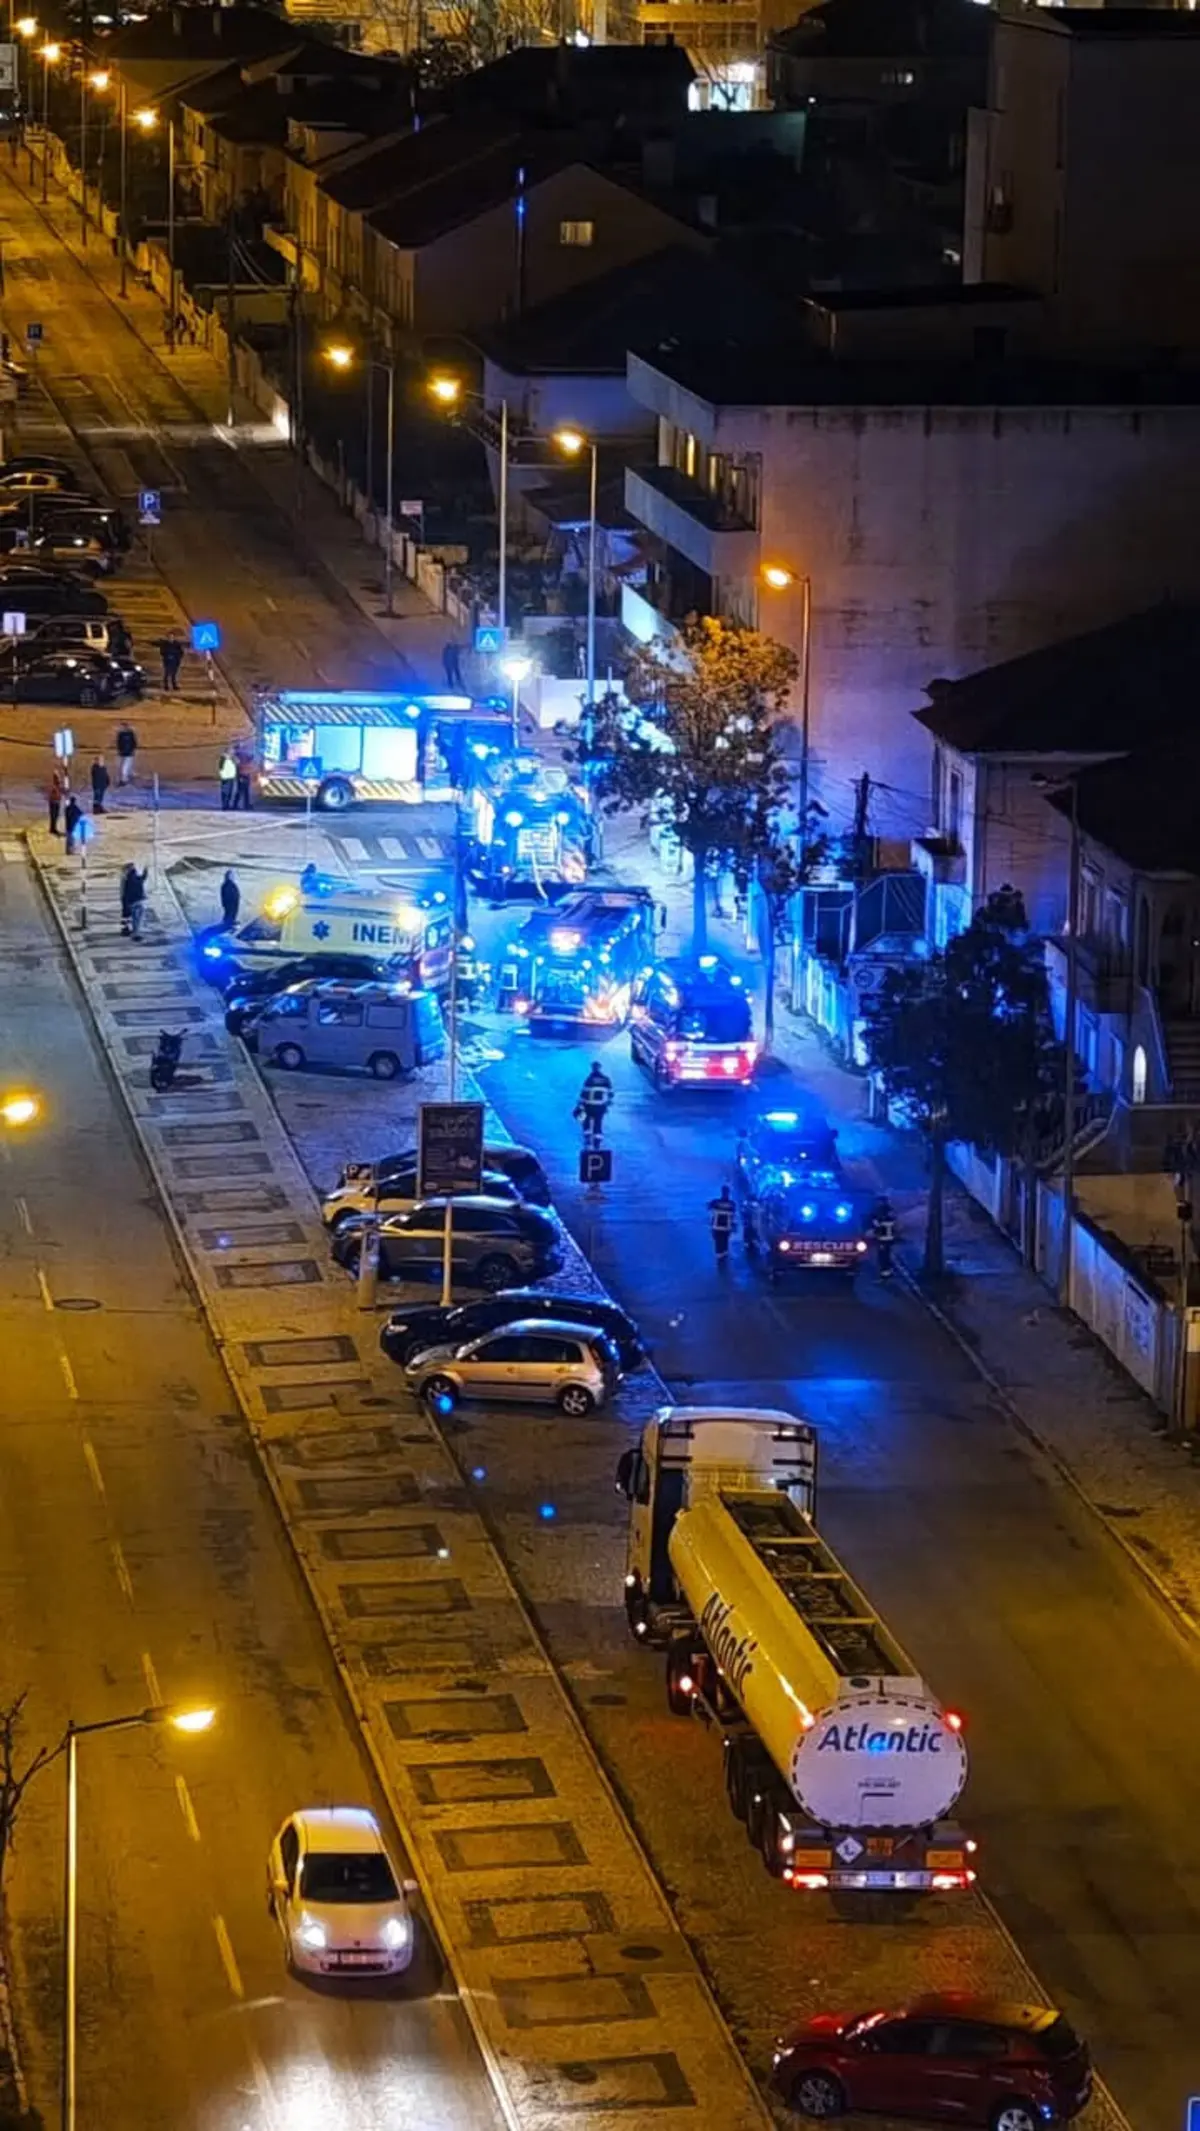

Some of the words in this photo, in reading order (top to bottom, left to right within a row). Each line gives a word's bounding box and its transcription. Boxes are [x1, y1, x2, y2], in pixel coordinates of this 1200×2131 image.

[144, 493, 155, 508] P
[353, 923, 410, 945] INEM
[588, 1155, 604, 1180] P
[793, 1241, 853, 1250] RESCUE
[702, 1592, 757, 1703] Atlantic
[818, 1722, 942, 1753] Atlantic
